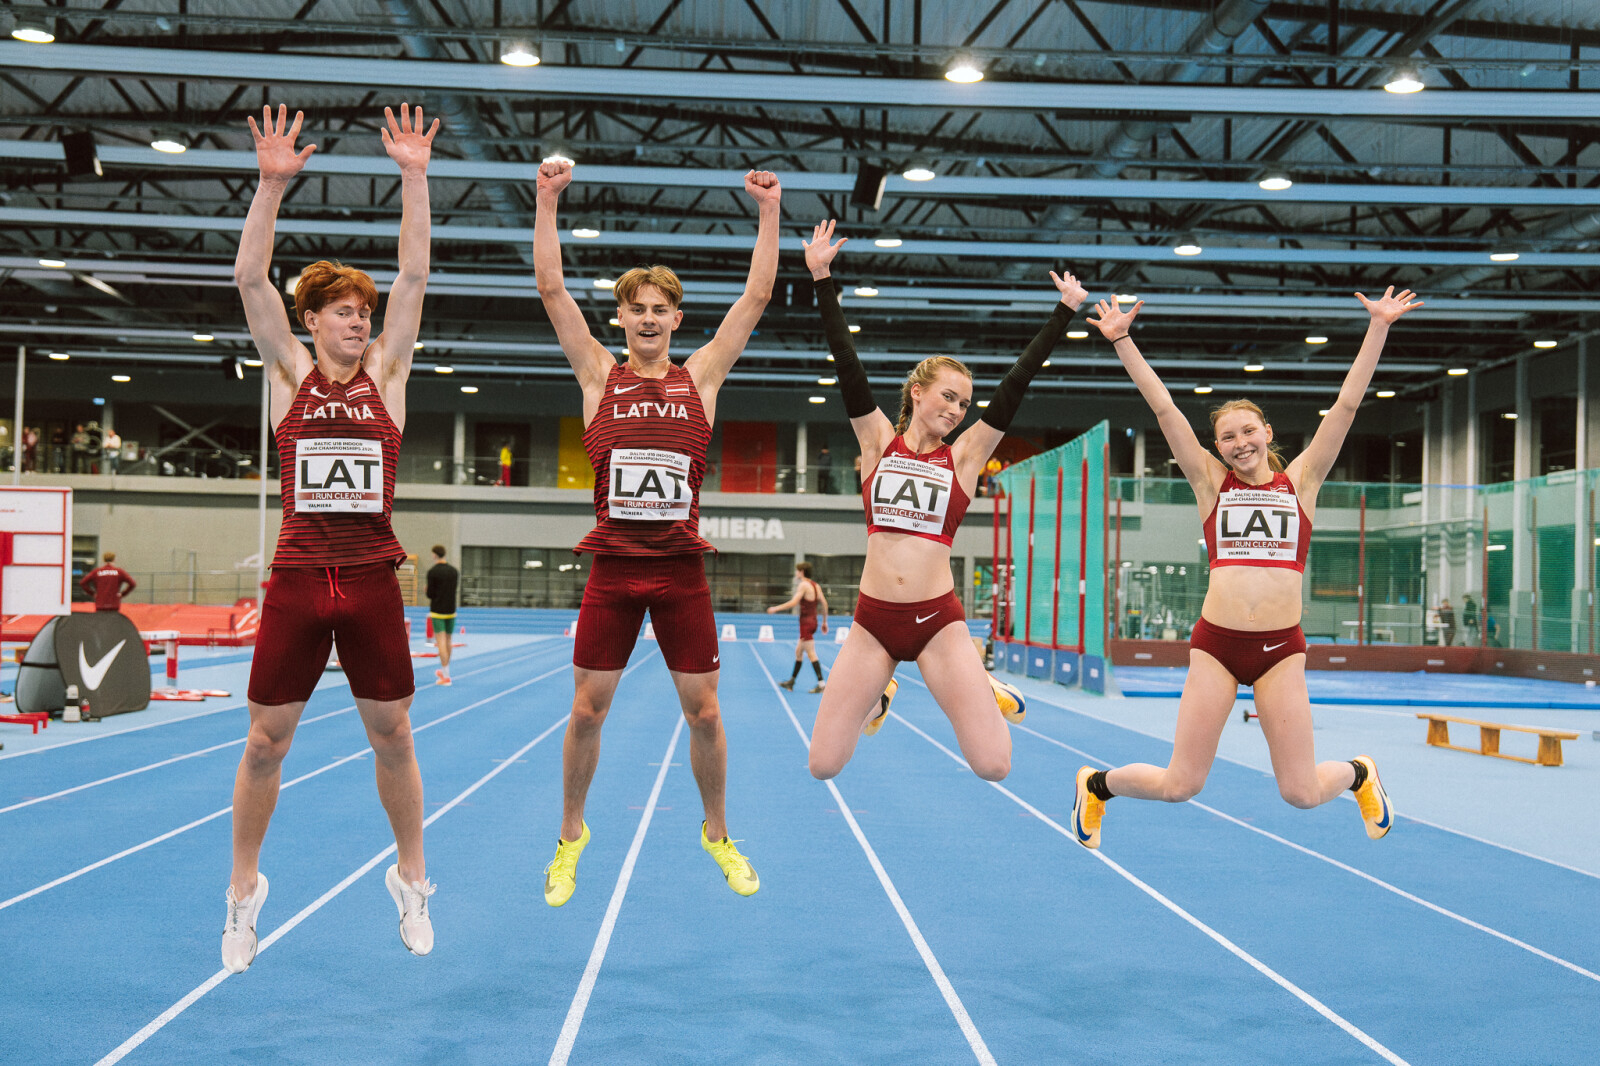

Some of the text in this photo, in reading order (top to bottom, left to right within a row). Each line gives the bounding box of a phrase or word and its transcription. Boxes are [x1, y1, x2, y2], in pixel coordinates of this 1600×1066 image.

[303, 402, 375, 420] LATVIA
[613, 402, 688, 420] LATVIA
[301, 459, 380, 489] LAT
[614, 468, 685, 500] LAT
[874, 475, 948, 512] LAT
[882, 507, 898, 515] RUN
[1221, 510, 1296, 538] LAT
[698, 516, 785, 540] MIERA
